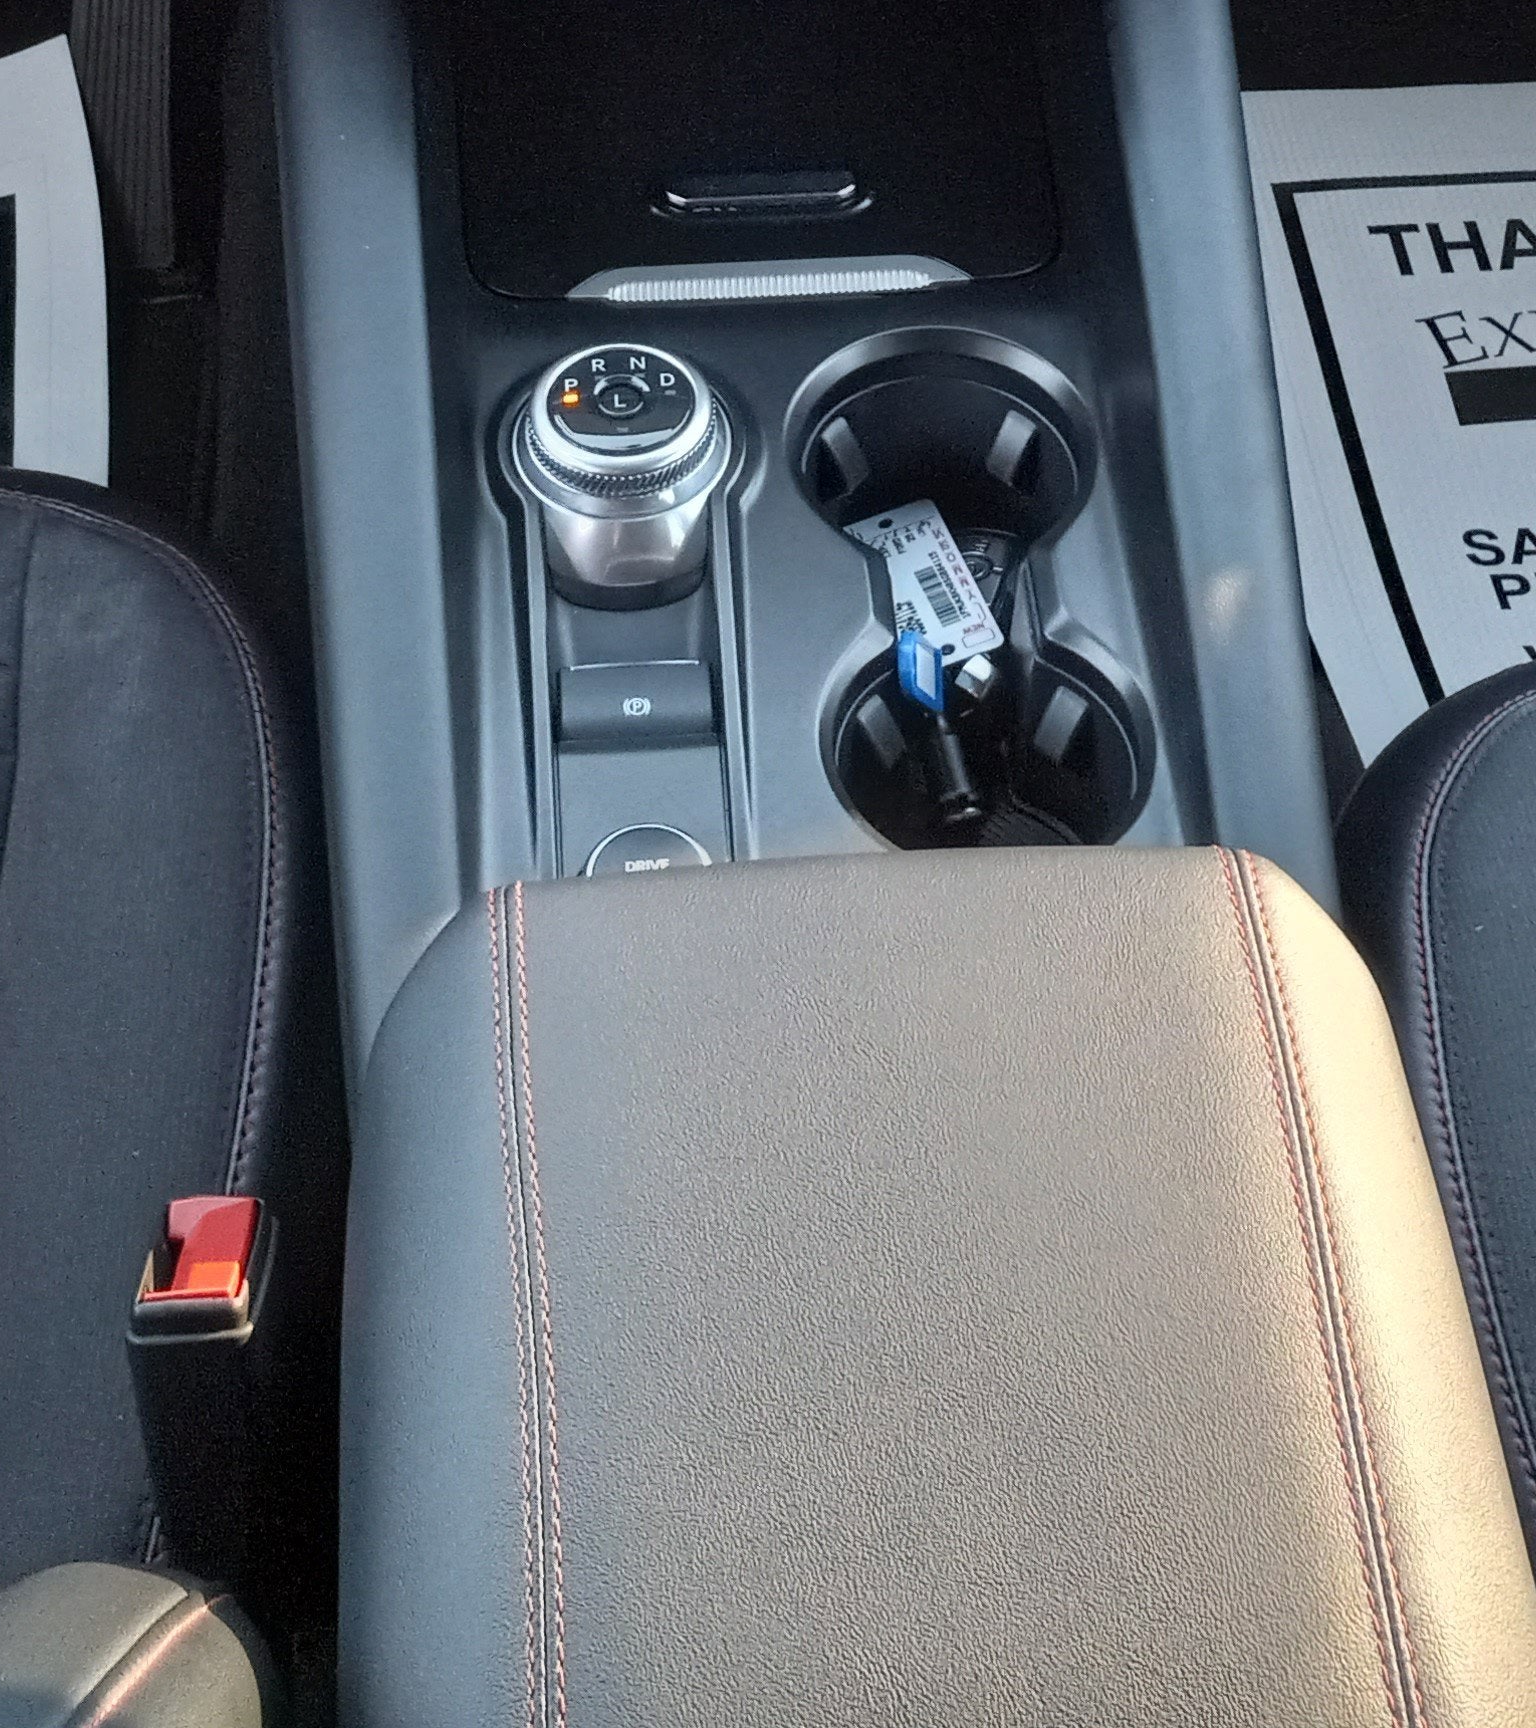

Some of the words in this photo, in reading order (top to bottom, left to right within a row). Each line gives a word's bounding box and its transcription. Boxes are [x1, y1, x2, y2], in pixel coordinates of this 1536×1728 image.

[564, 378, 579, 392] P
[591, 358, 606, 372] R
[629, 356, 646, 370] N
[660, 373, 676, 387] D
[614, 394, 627, 408] L
[624, 858, 670, 872] DRIVE
